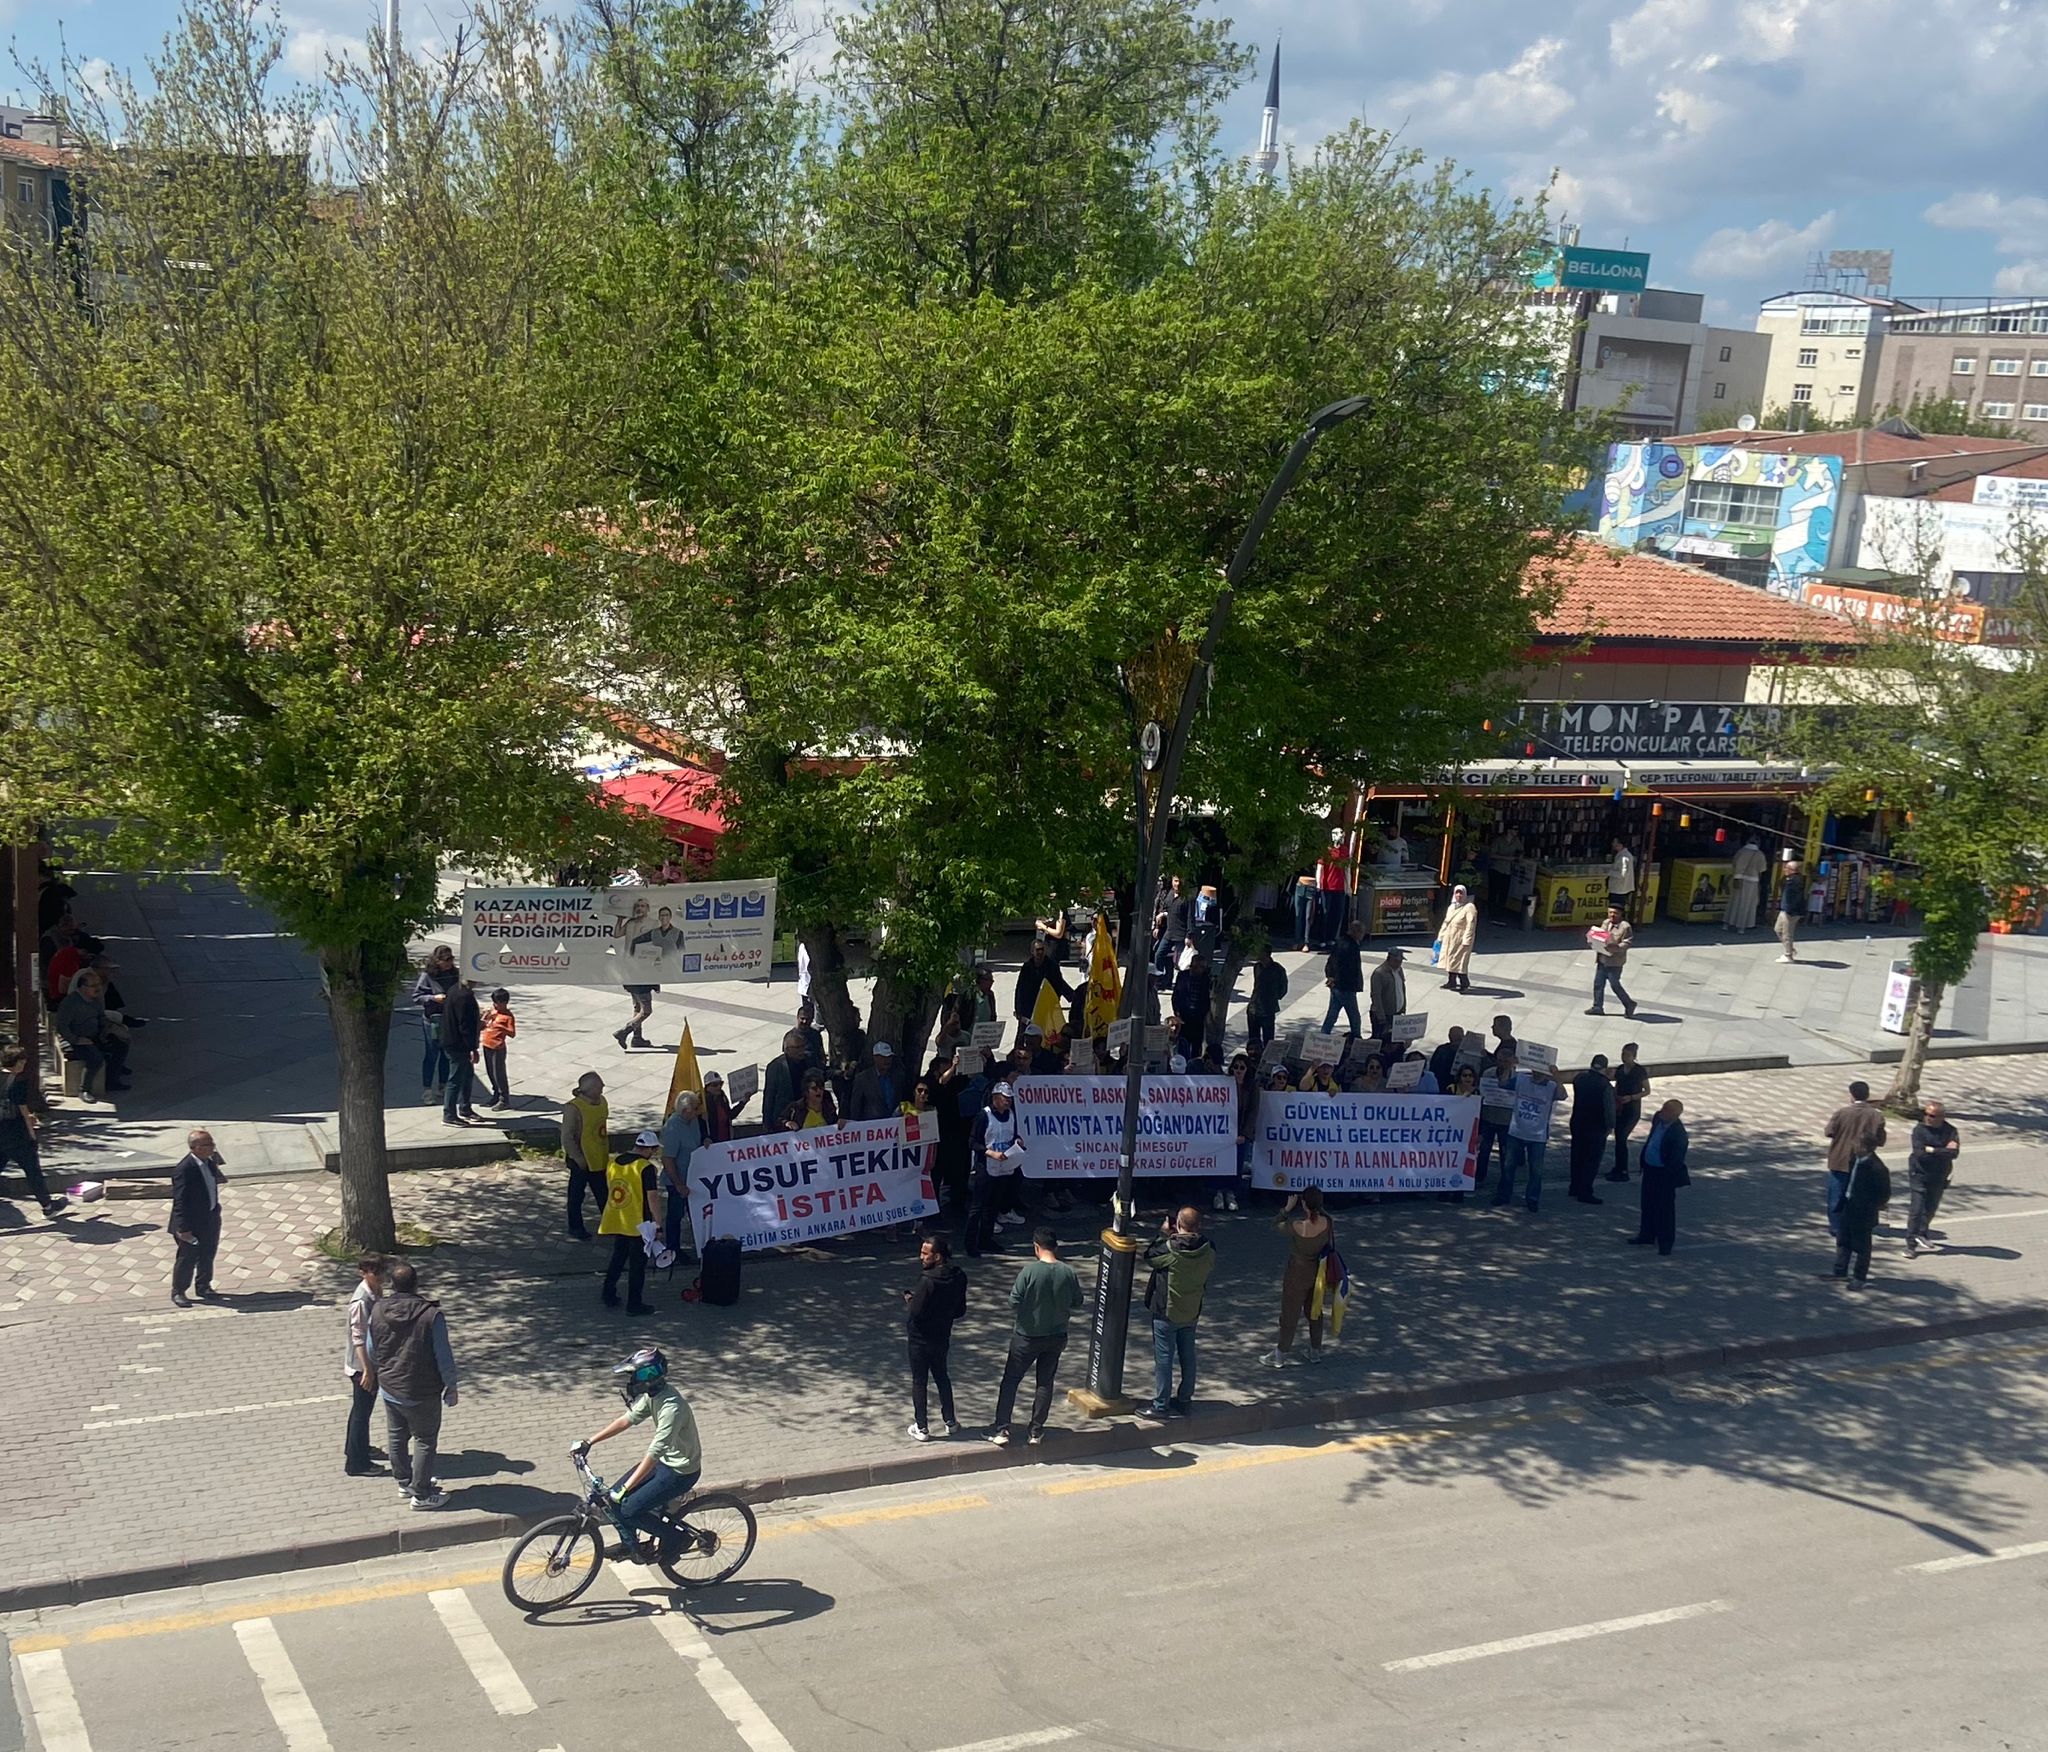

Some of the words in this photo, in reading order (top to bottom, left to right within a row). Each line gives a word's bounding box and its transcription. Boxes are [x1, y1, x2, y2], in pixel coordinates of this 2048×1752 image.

[1568, 261, 1643, 278] BELLONA
[1563, 736, 1691, 753] TELEFONCULAR
[1640, 774, 1661, 784] CEP
[1585, 883, 1602, 894] CEP
[474, 898, 592, 911] KAZANCIMIZ
[474, 912, 537, 924] ALLAH
[731, 951, 746, 961] 66
[748, 949, 762, 960] 39
[1019, 1083, 1087, 1107] SÖMÜRÜYE,
[1148, 1086, 1194, 1108] SAVAŞA
[1196, 1086, 1230, 1107] KARŞI
[1285, 1102, 1358, 1121] GÜVENLİ
[1519, 1100, 1541, 1114] SOL
[1023, 1115, 1032, 1136] 1
[1034, 1114, 1103, 1136] MAYIS'TA
[1105, 1110, 1229, 1135] TADOĞAN'DAYIZ!
[1266, 1123, 1342, 1143] GÜVENLİ
[1348, 1128, 1421, 1143] GELECEK
[1427, 1125, 1464, 1147] İÇİN
[727, 1140, 789, 1163] TARİKAT
[795, 1139, 810, 1153] ve
[814, 1131, 861, 1149] MESEM
[1047, 1159, 1079, 1170] EMEK
[1083, 1160, 1096, 1170] ve
[1100, 1156, 1166, 1170] DEMKRASİ
[1170, 1155, 1217, 1171] GÜÇLERİ
[1267, 1149, 1274, 1166] 1
[1280, 1149, 1351, 1169] MAYIS'TA
[1355, 1150, 1459, 1169] ALANLARDAYIZ
[699, 1159, 819, 1200] YUSUF
[829, 1142, 921, 1180] TEKİN
[1290, 1176, 1324, 1188] EĞİTİM
[1326, 1177, 1344, 1188] SEN
[1349, 1177, 1385, 1188] ANKARA
[1387, 1176, 1395, 1188] 4
[1399, 1177, 1421, 1188] NOLU
[1424, 1176, 1447, 1190] ŞUBE
[777, 1182, 887, 1220] İSTİFA
[740, 1230, 777, 1248] EĞİTİM
[780, 1227, 801, 1242] SEN
[807, 1220, 847, 1237] ANKARA
[848, 1213, 857, 1229] 4
[860, 1209, 885, 1226] NOLU
[886, 1206, 908, 1223] ŞUBE
[1090, 1340, 1101, 1388] SİNCAN
[1096, 1261, 1110, 1336] BELEDİYESİ
